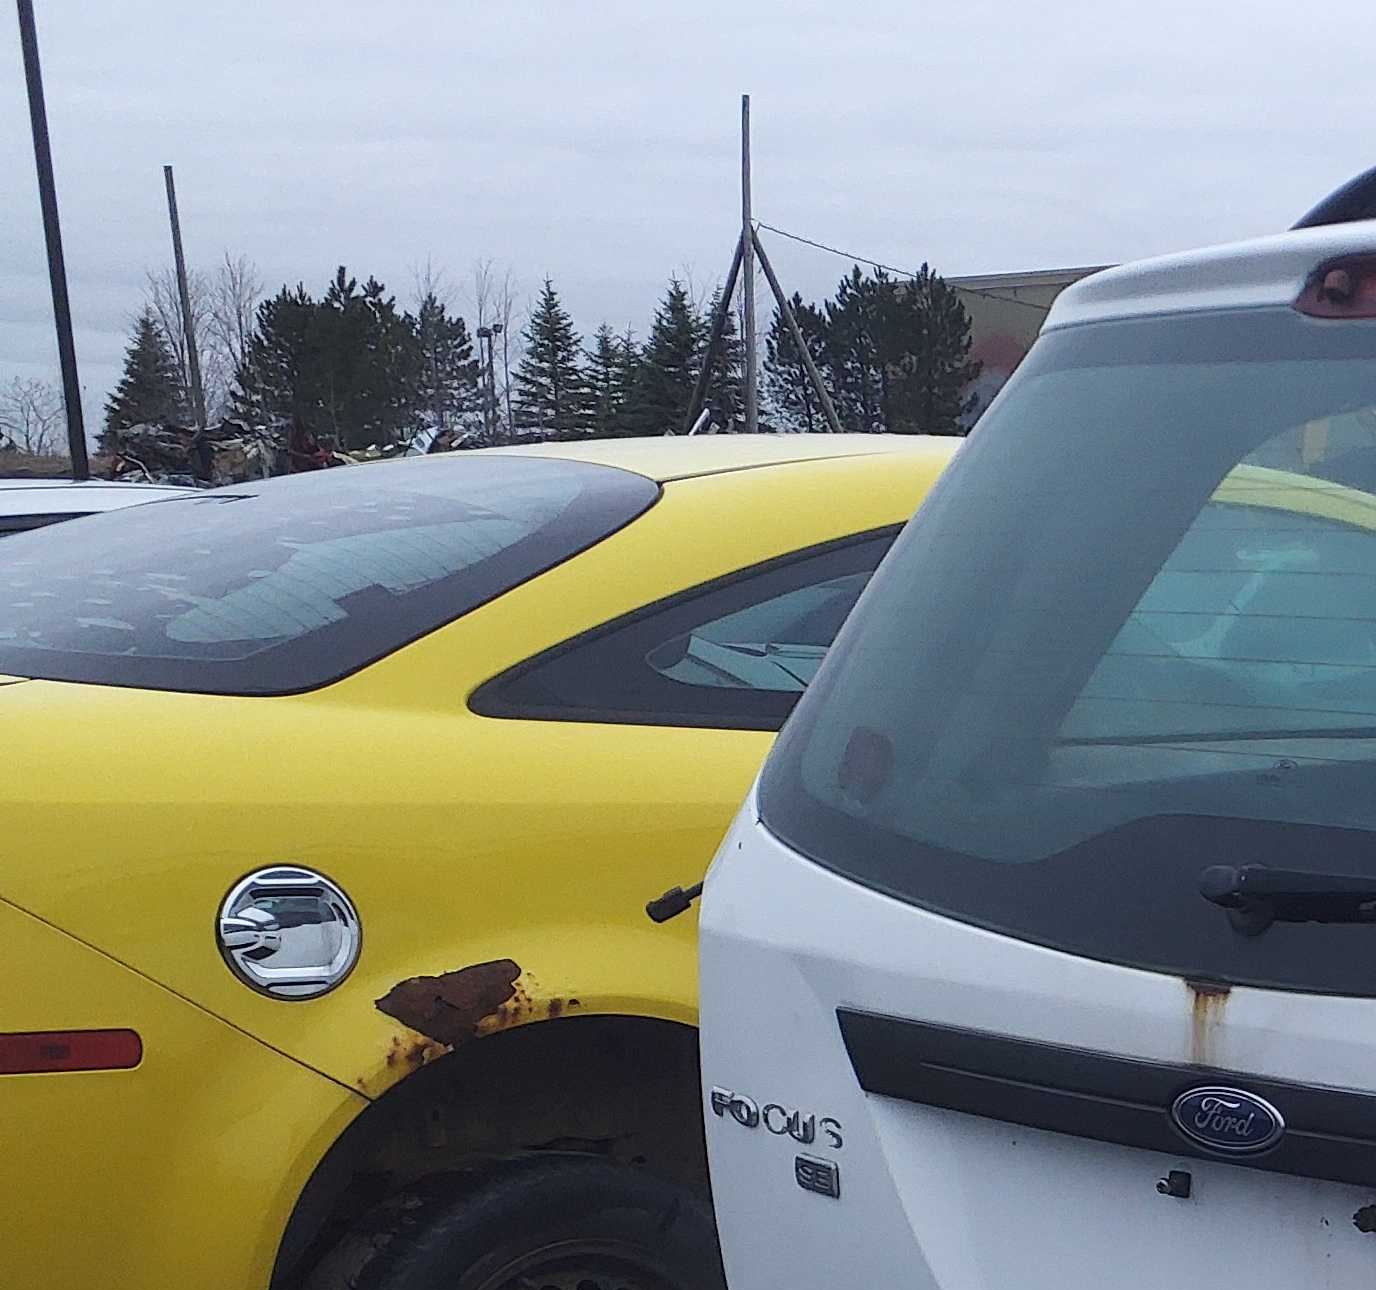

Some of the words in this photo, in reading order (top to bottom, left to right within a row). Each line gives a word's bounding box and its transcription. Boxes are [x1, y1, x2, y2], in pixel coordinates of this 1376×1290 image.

[711, 1086, 844, 1150] FOCUS
[1194, 1096, 1257, 1139] Ford
[796, 1154, 837, 1193] SE
